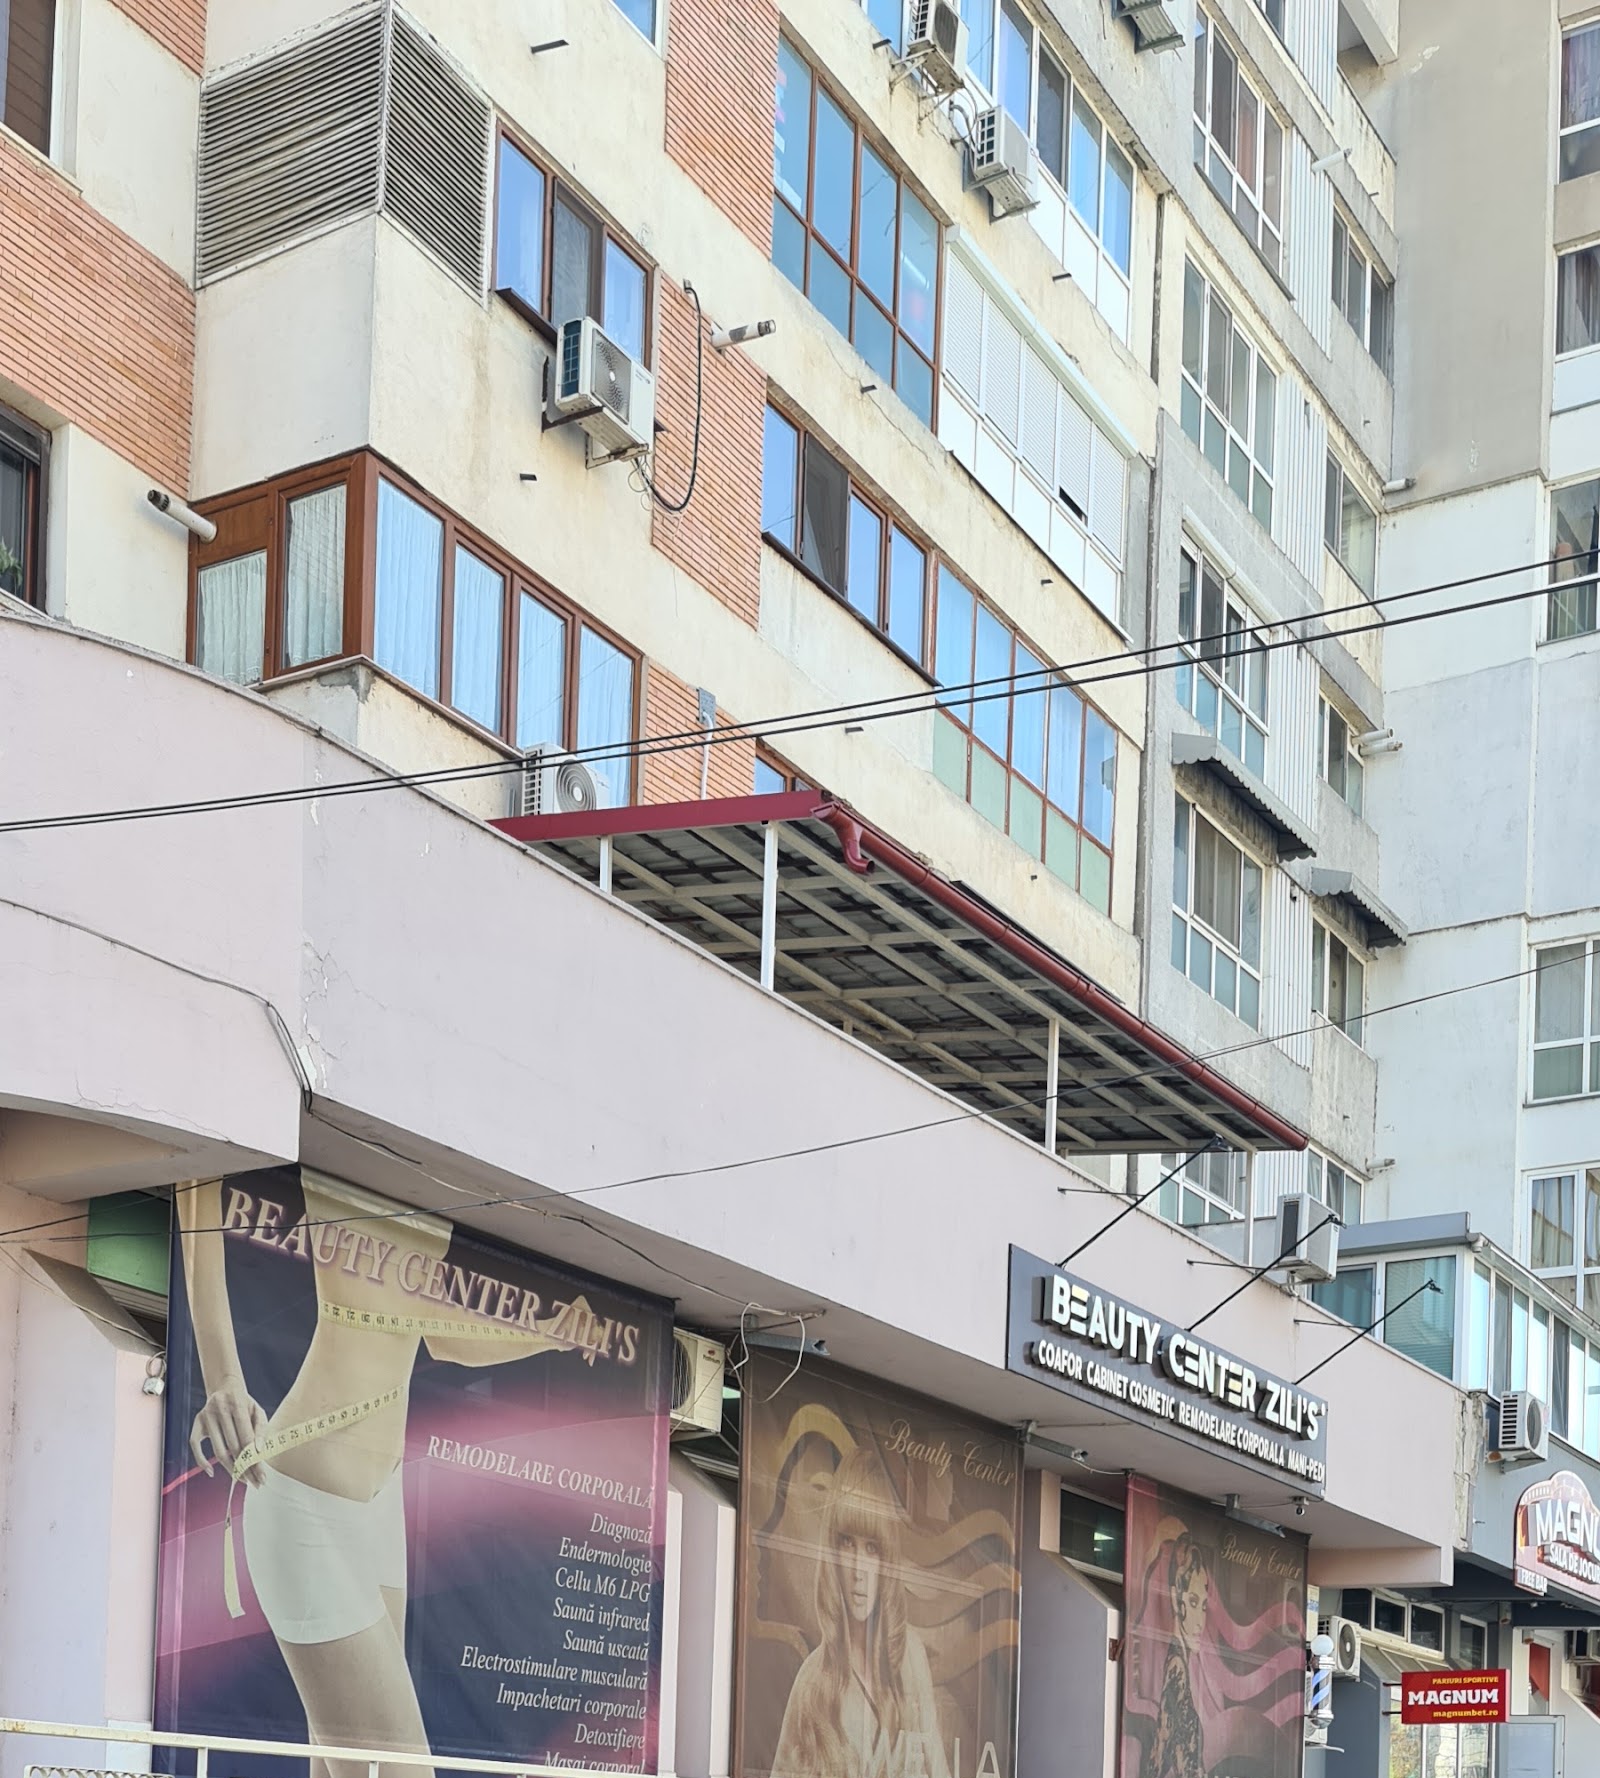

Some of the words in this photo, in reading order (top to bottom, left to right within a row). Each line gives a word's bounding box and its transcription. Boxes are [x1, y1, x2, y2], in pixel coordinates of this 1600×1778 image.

[222, 1187, 394, 1284] BEAUTY
[400, 1249, 540, 1332] CENTER
[546, 1300, 639, 1361] ZILI'S
[1051, 1274, 1161, 1365] BEAUTY
[1169, 1333, 1257, 1413] CENTER
[1038, 1340, 1082, 1381] COAFOR
[1087, 1360, 1128, 1399] CABINET
[1129, 1380, 1175, 1420] COSMETIC
[1179, 1401, 1235, 1446] REMODELARE
[1237, 1428, 1284, 1467] CORPORALA
[1288, 1448, 1325, 1483] MANI-PEDI
[427, 1435, 554, 1485] REMODELARE
[885, 1419, 952, 1478] Beauty
[963, 1441, 1015, 1486] Center
[590, 1512, 652, 1544] Diagnoză
[559, 1537, 651, 1576] Endermologie
[1221, 1533, 1261, 1576] Beauty
[1268, 1546, 1302, 1579] Center
[1550, 1543, 1567, 1570] SALA
[1569, 1552, 1579, 1573] DE
[555, 1567, 591, 1593] Cellu
[594, 1574, 616, 1597] M6
[619, 1582, 651, 1603] LPG
[1522, 1568, 1536, 1588] FREE
[1536, 1574, 1547, 1592] BAR
[553, 1597, 595, 1624] Saună
[599, 1606, 650, 1632] infrared
[563, 1629, 604, 1655] Saună
[608, 1641, 649, 1661] uscată
[460, 1646, 577, 1681] Electrostimulare
[581, 1667, 647, 1691] musculară
[1463, 1676, 1499, 1684] SPORTIVE
[496, 1682, 582, 1712] Impachetari
[584, 1697, 647, 1721] corporale
[1407, 1688, 1499, 1706] MAGNUM
[1433, 1708, 1499, 1718] magnumbet.ro
[574, 1723, 645, 1752] Detoxifiere
